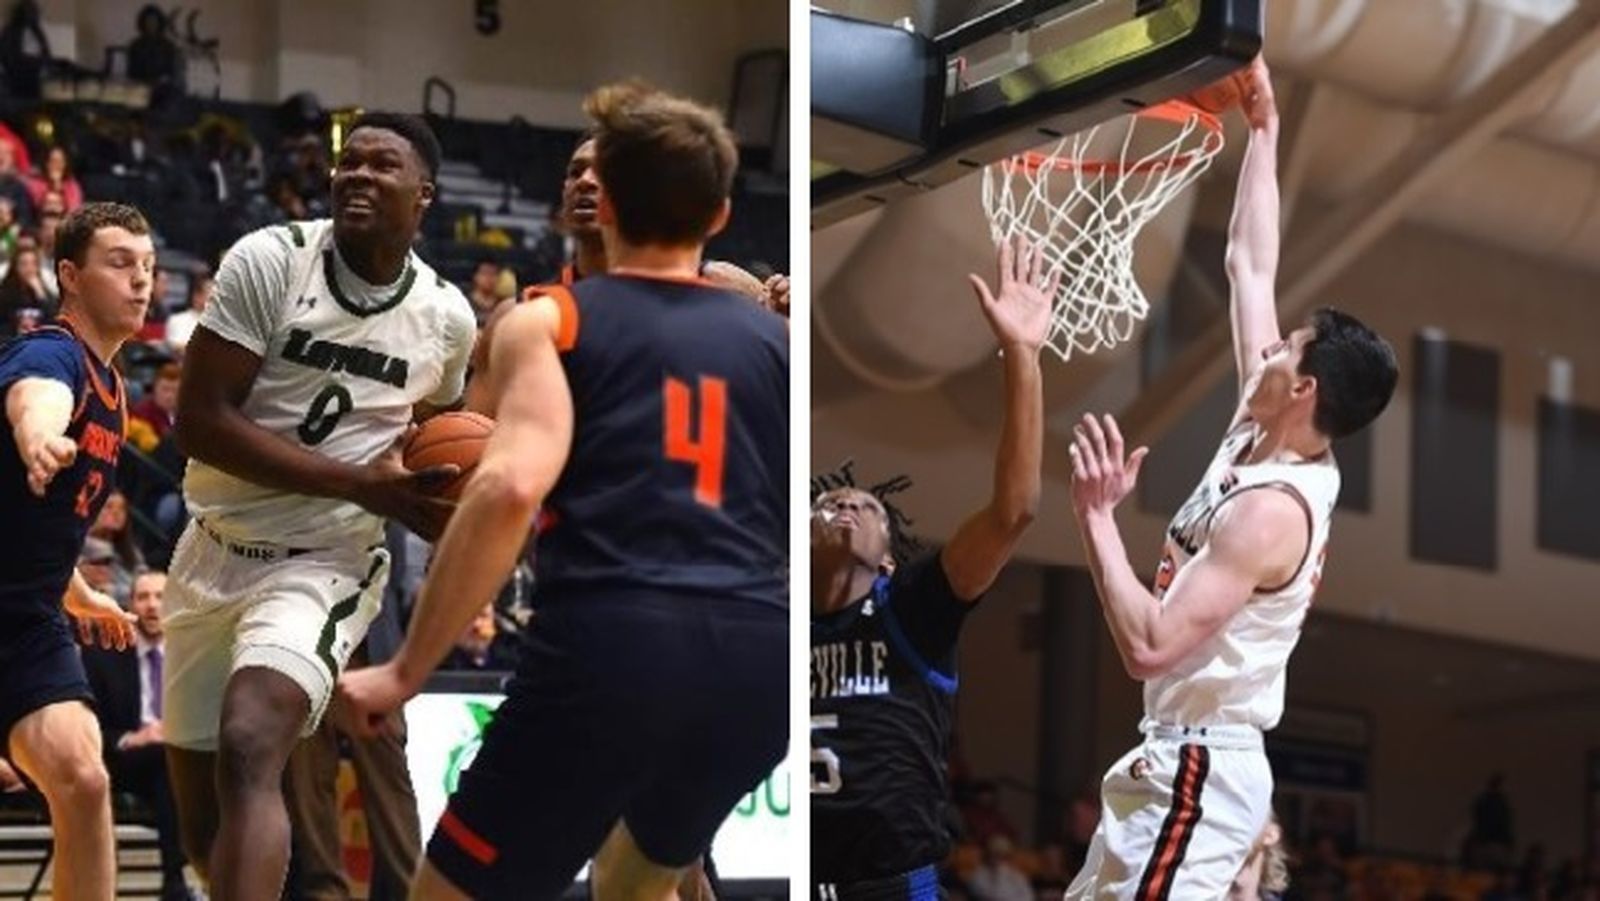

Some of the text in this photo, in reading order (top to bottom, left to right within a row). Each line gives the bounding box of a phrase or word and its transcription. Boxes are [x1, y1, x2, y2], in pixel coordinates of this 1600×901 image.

[474, 0, 502, 36] 5
[297, 384, 353, 446] 0
[662, 375, 728, 509] 4
[810, 713, 842, 794] 5
